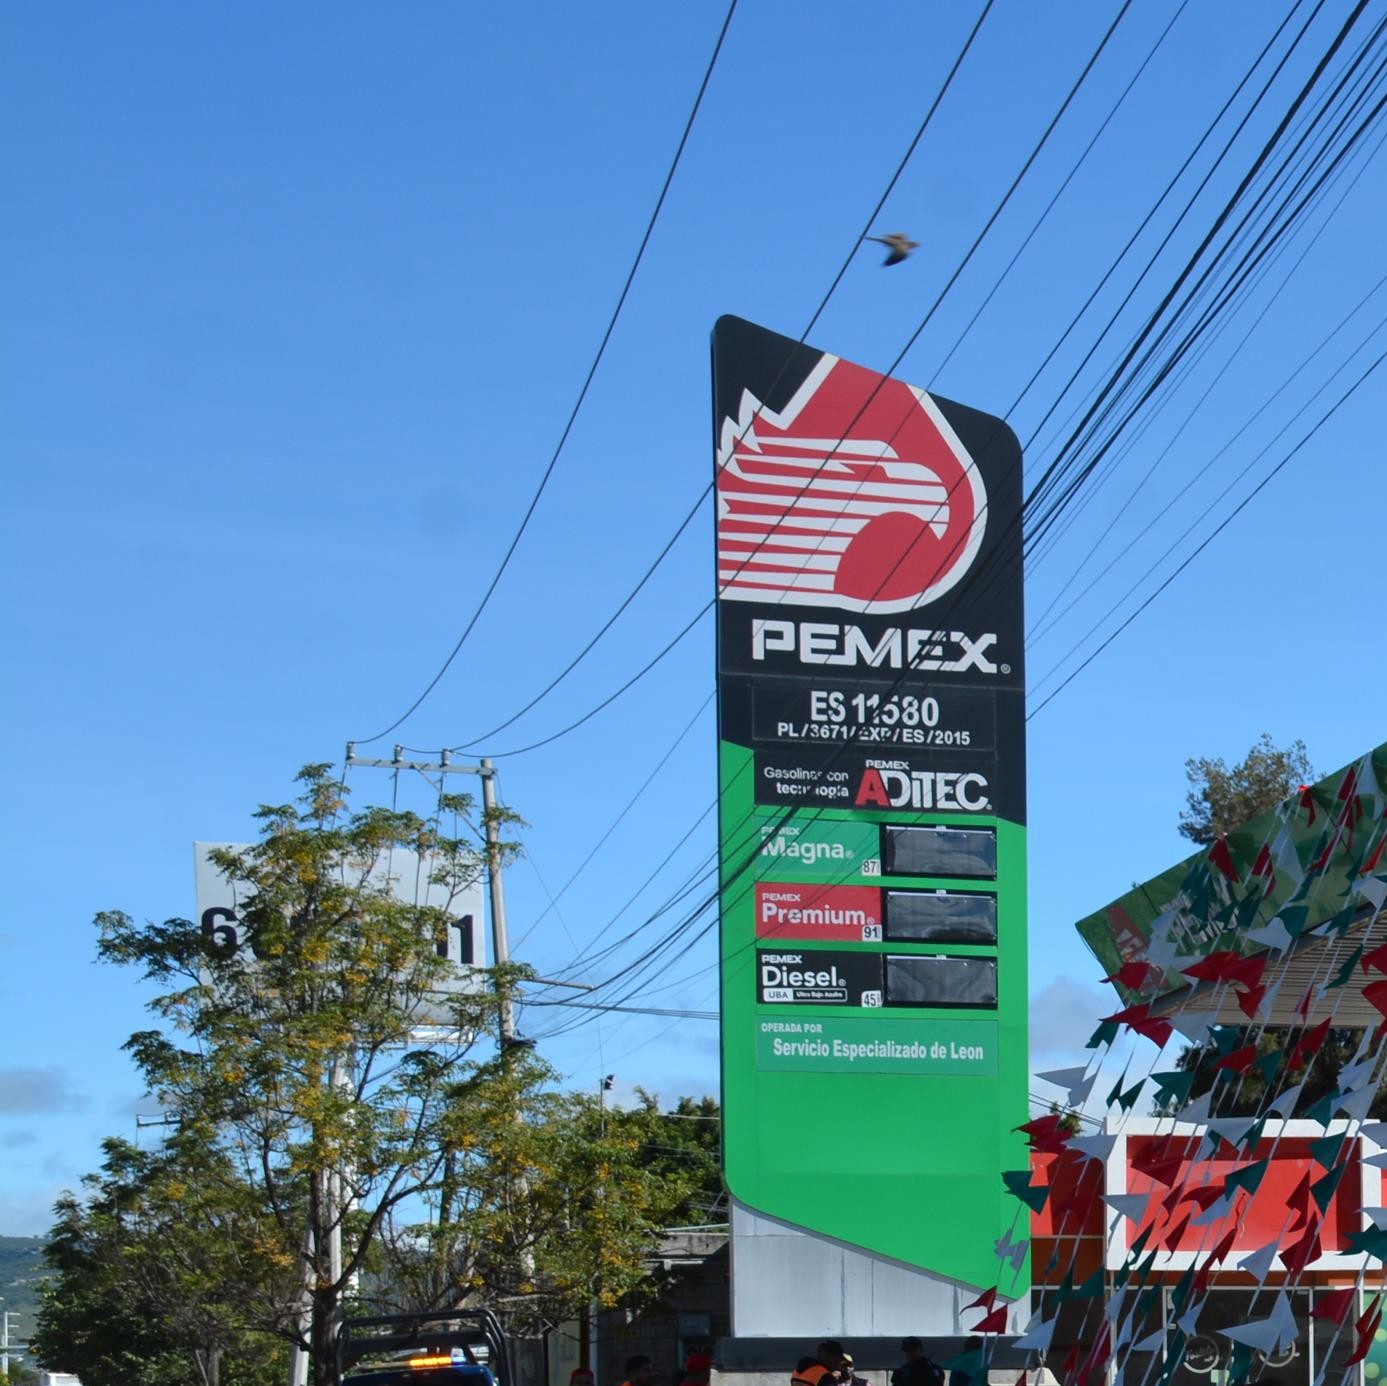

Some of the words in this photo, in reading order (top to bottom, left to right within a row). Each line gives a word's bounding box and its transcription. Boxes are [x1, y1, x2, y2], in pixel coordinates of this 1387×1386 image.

[752, 619, 997, 674] PEMEX
[810, 691, 846, 722] ES
[866, 759, 909, 770] PEMEX
[762, 836, 845, 864] Magna
[863, 861, 876, 873] 87
[762, 893, 801, 902] PEMEX
[762, 903, 866, 926] Premium
[863, 926, 878, 939] 91
[762, 955, 802, 964] PEMEX
[762, 966, 837, 987] Diesel
[768, 991, 789, 999] UBA
[762, 1023, 802, 1033] OPERADA
[804, 1024, 823, 1034] POR
[773, 1038, 829, 1057] Servicio
[833, 1039, 927, 1061] Especializado
[930, 1041, 947, 1059] de
[950, 1042, 984, 1061] Leon
